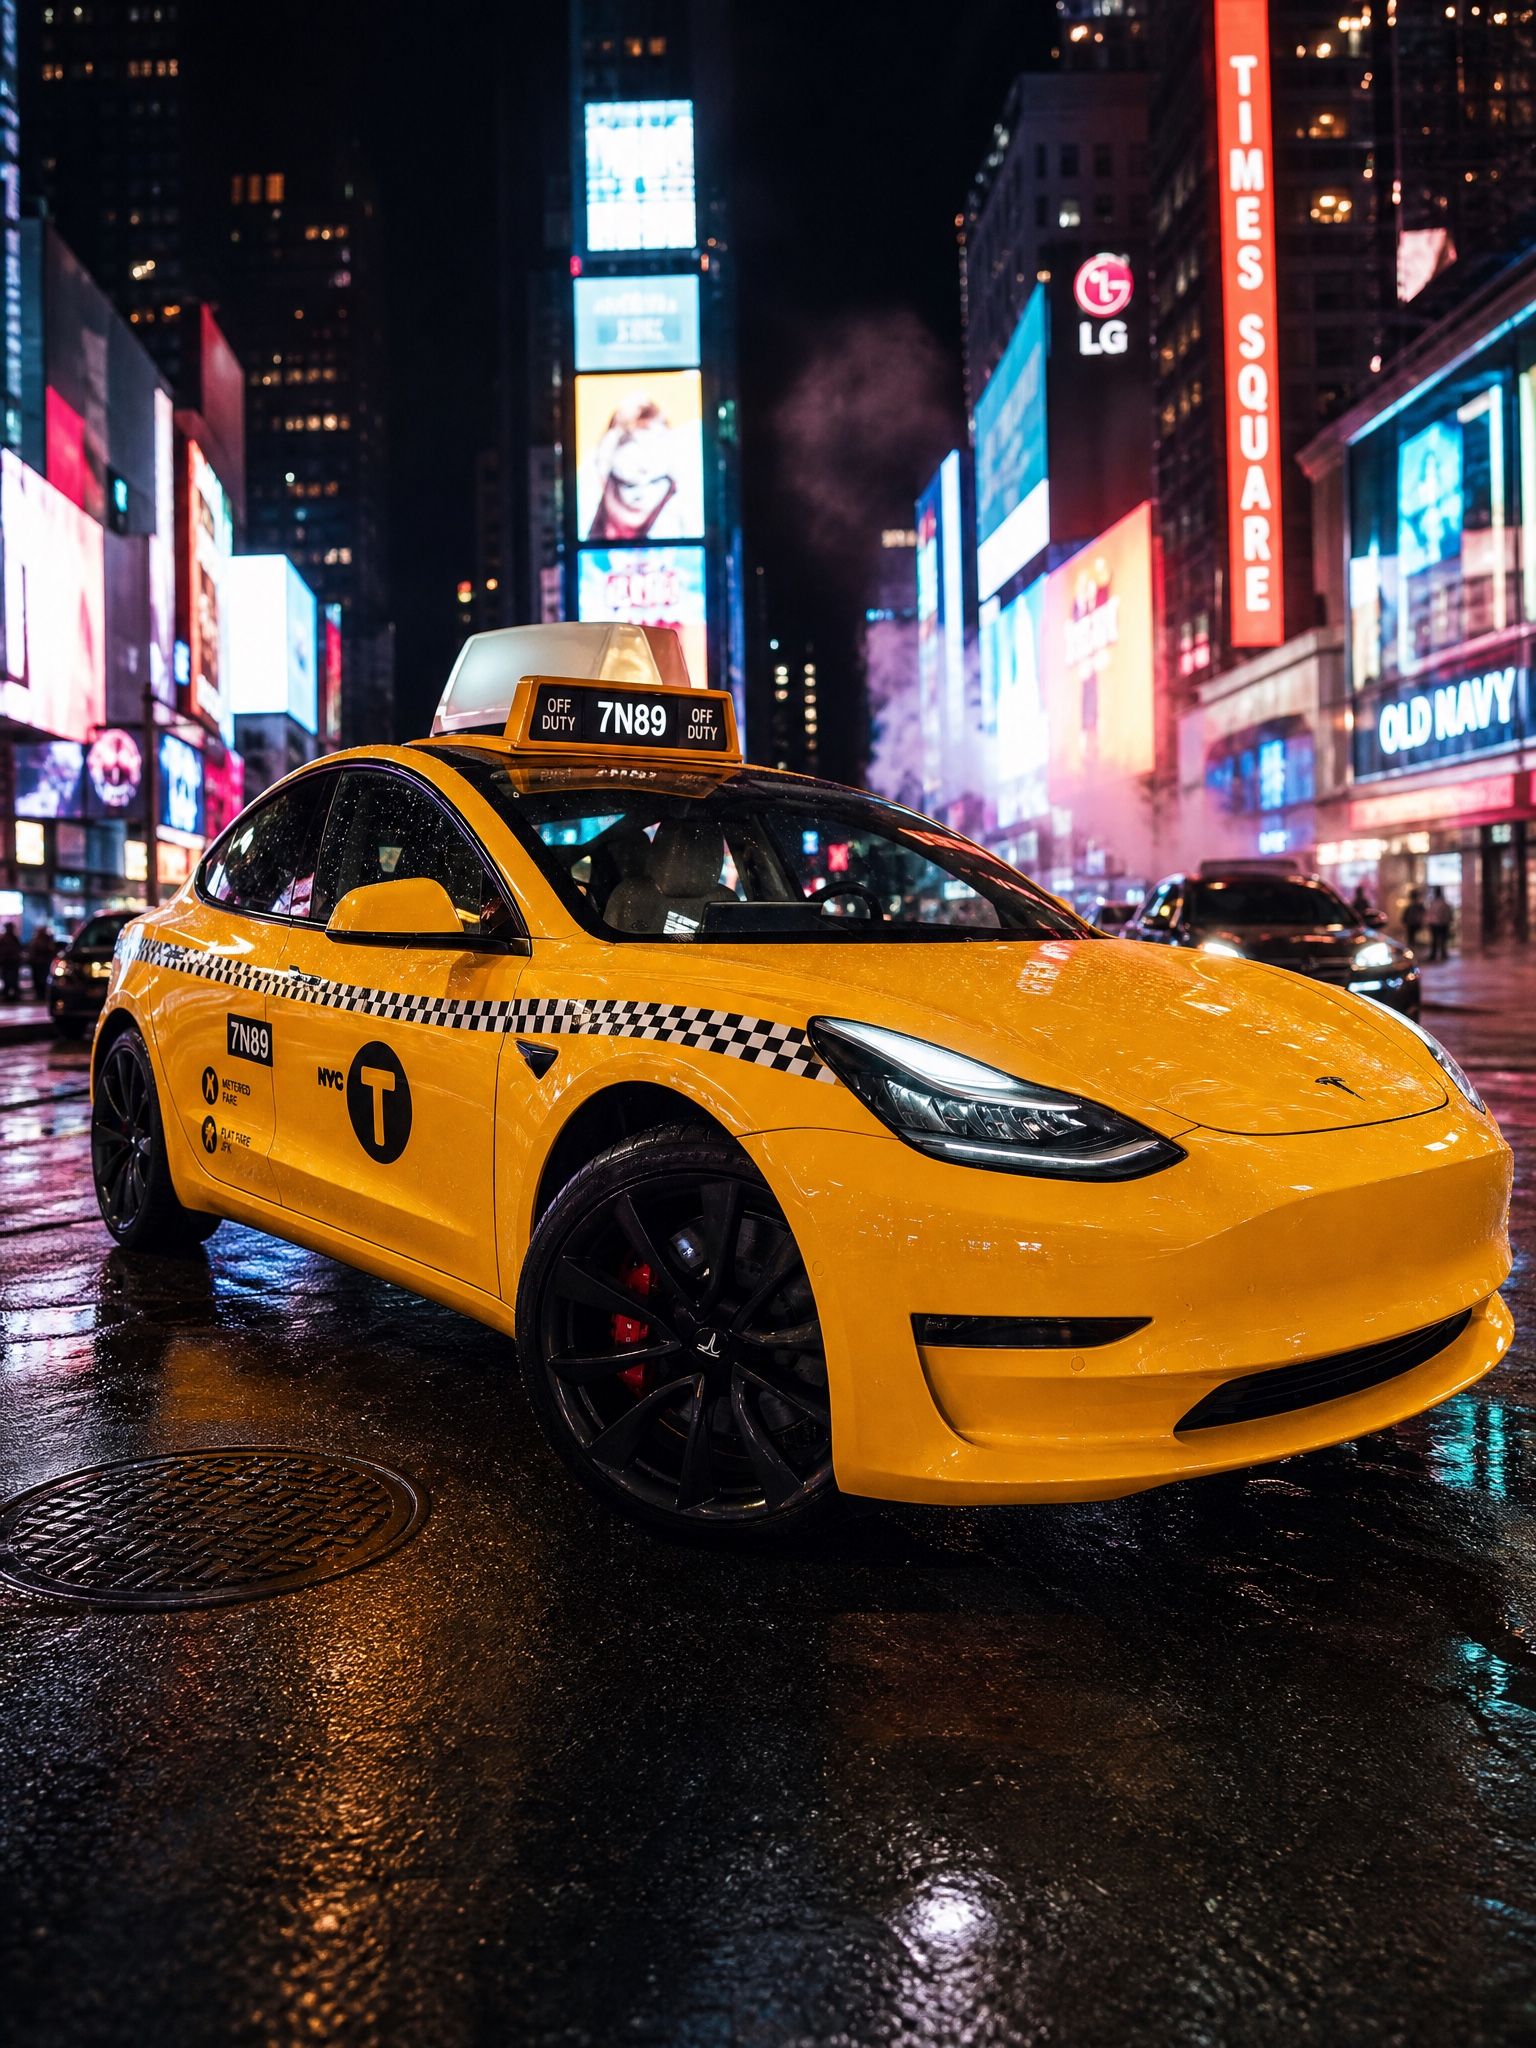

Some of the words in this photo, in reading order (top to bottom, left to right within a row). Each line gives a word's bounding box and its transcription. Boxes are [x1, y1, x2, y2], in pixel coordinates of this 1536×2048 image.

[1229, 55, 1264, 290] TIMES
[1079, 319, 1128, 355] LG
[1237, 313, 1272, 612] SQUARE
[542, 715, 576, 732] DUTY
[547, 698, 572, 713] OFF
[597, 701, 667, 737] 7N89
[691, 708, 713, 724] OFF
[1379, 695, 1432, 754] OLD
[1434, 666, 1517, 741] NAVY
[687, 725, 718, 741] DUTY
[230, 1021, 269, 1059] 7N89
[317, 1066, 344, 1091] NYC
[360, 1065, 396, 1146] T
